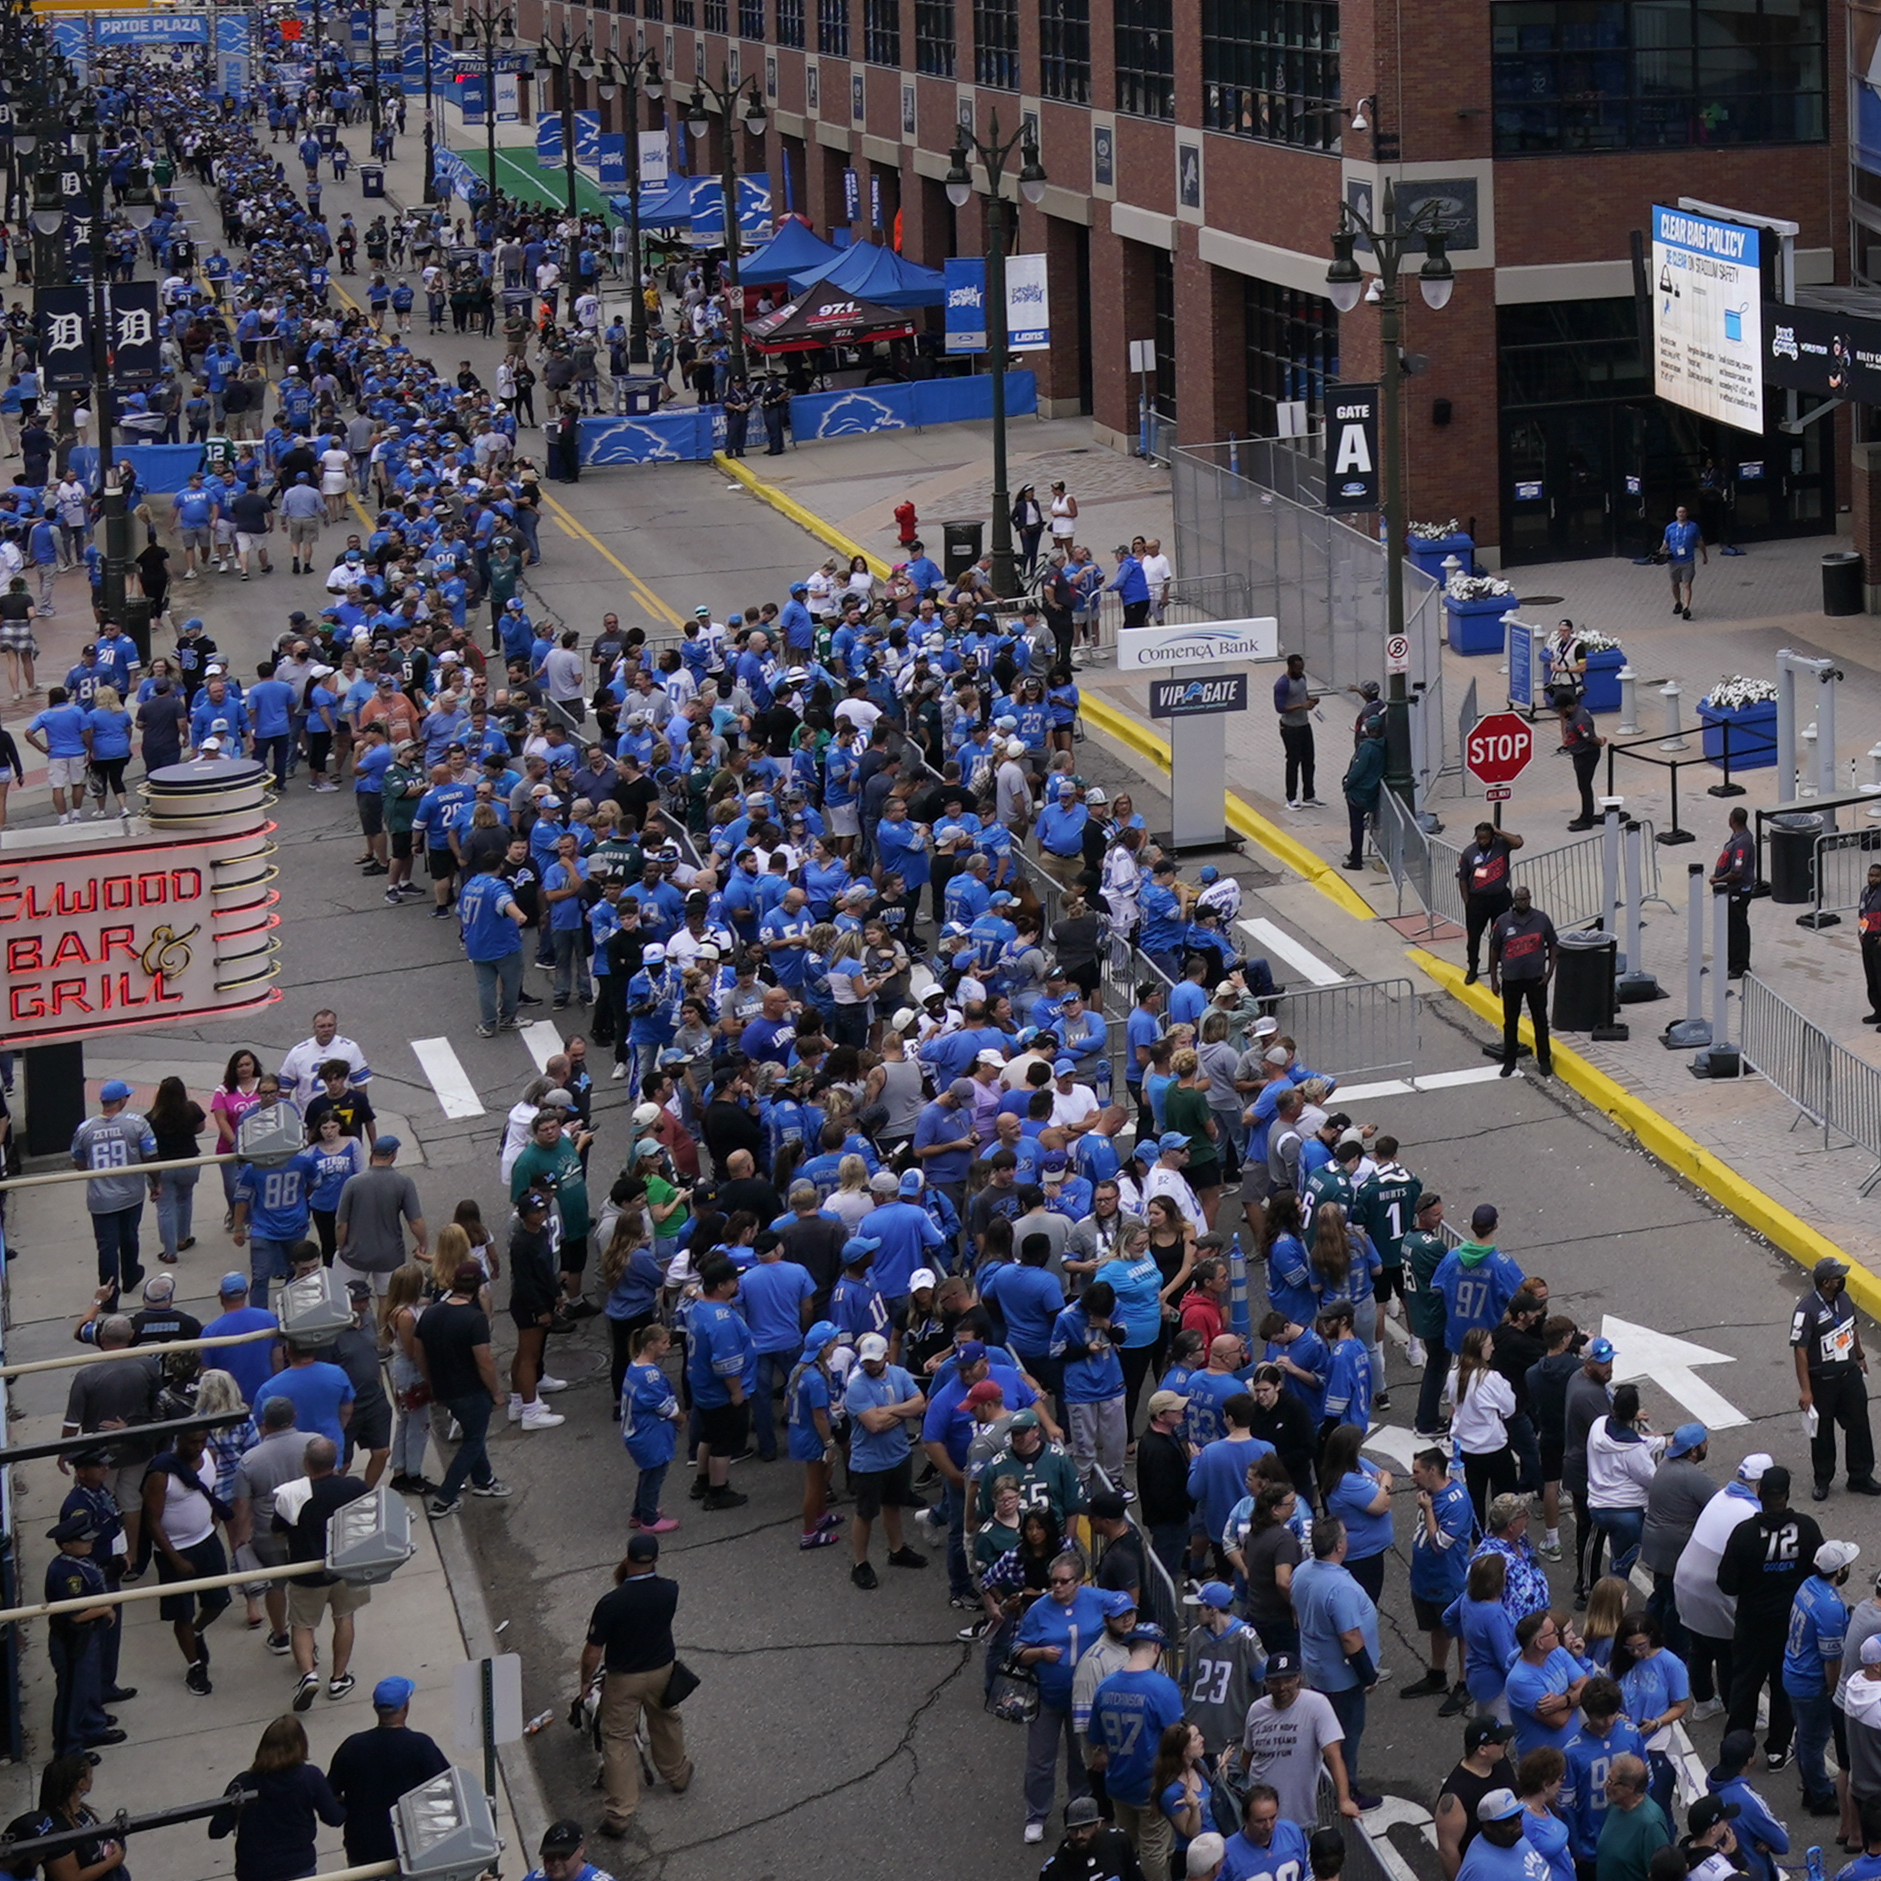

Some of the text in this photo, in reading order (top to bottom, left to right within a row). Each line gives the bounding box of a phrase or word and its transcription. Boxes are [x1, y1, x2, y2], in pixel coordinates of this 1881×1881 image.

[100, 18, 201, 35] PRIDE PLAZA
[499, 58, 522, 71] LINE
[1661, 213, 1745, 259] CLEAR BAG POLICY
[818, 301, 855, 316] 97.1
[1015, 330, 1045, 342] LIONS
[1336, 404, 1370, 419] GATE
[206, 445, 225, 461] 12
[1334, 424, 1372, 474] A
[1219, 639, 1259, 655] Bank
[1159, 685, 1184, 707] VIP
[1201, 680, 1239, 702] GATE
[1470, 730, 1529, 764] STOP
[7, 924, 201, 981] BAR &
[10, 968, 183, 1021] GRILL
[92, 1141, 128, 1169] 69
[265, 1171, 300, 1209] 88
[1385, 1202, 1404, 1240] 1
[1456, 1281, 1488, 1319] 97
[1760, 1523, 1799, 1561] 72
[1067, 1624, 1078, 1666] 1
[1191, 1659, 1232, 1704] 23
[1100, 1711, 1143, 1755] 97
